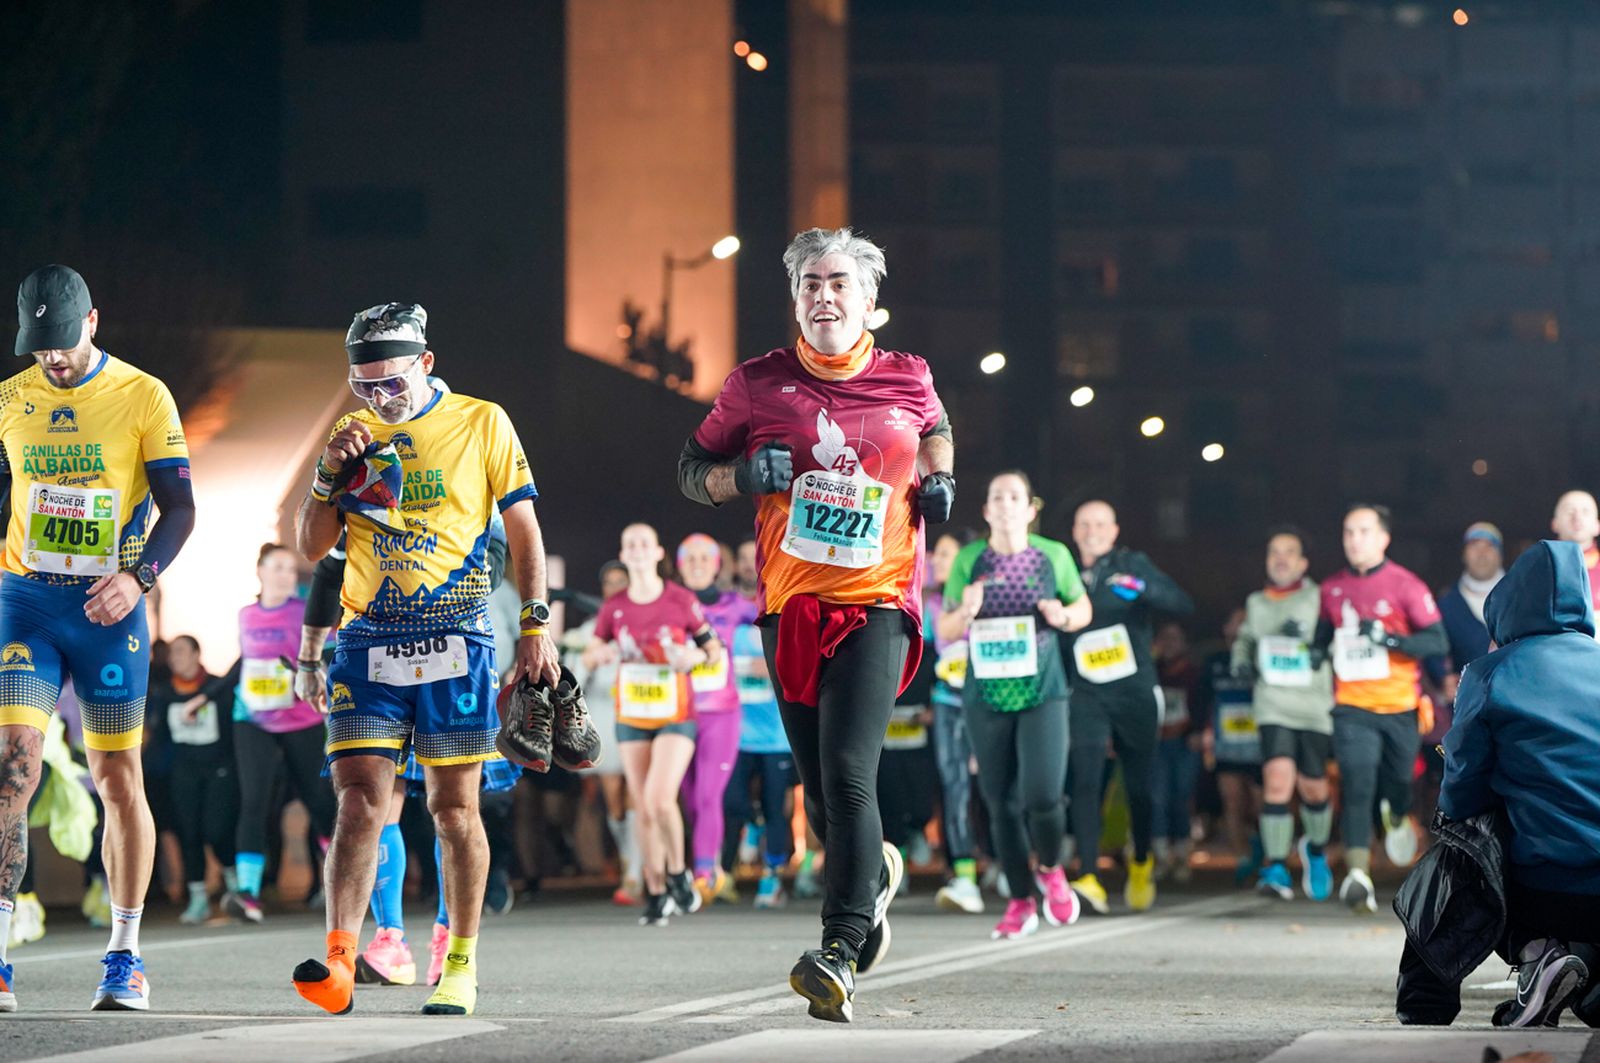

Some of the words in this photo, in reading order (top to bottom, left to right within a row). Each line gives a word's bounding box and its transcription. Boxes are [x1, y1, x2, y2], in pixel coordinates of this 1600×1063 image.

[23, 444, 81, 458] CANILLAS
[86, 443, 103, 456] DE
[23, 456, 106, 474] ALBAIDA
[831, 454, 857, 476] 43
[426, 469, 443, 482] DE
[815, 480, 845, 495] NOCHE
[846, 486, 857, 497] DE
[49, 495, 73, 507] NOCHE
[74, 498, 86, 507] DE
[803, 489, 821, 502] SAN
[823, 495, 855, 508] ANTÓN
[38, 504, 54, 514] SAN
[55, 506, 86, 518] ANTÓN
[804, 502, 873, 539] 12227
[43, 517, 99, 546] 4705
[372, 527, 438, 558] RINCÓN
[380, 559, 427, 571] DENTAL
[407, 658, 429, 666] Susana
